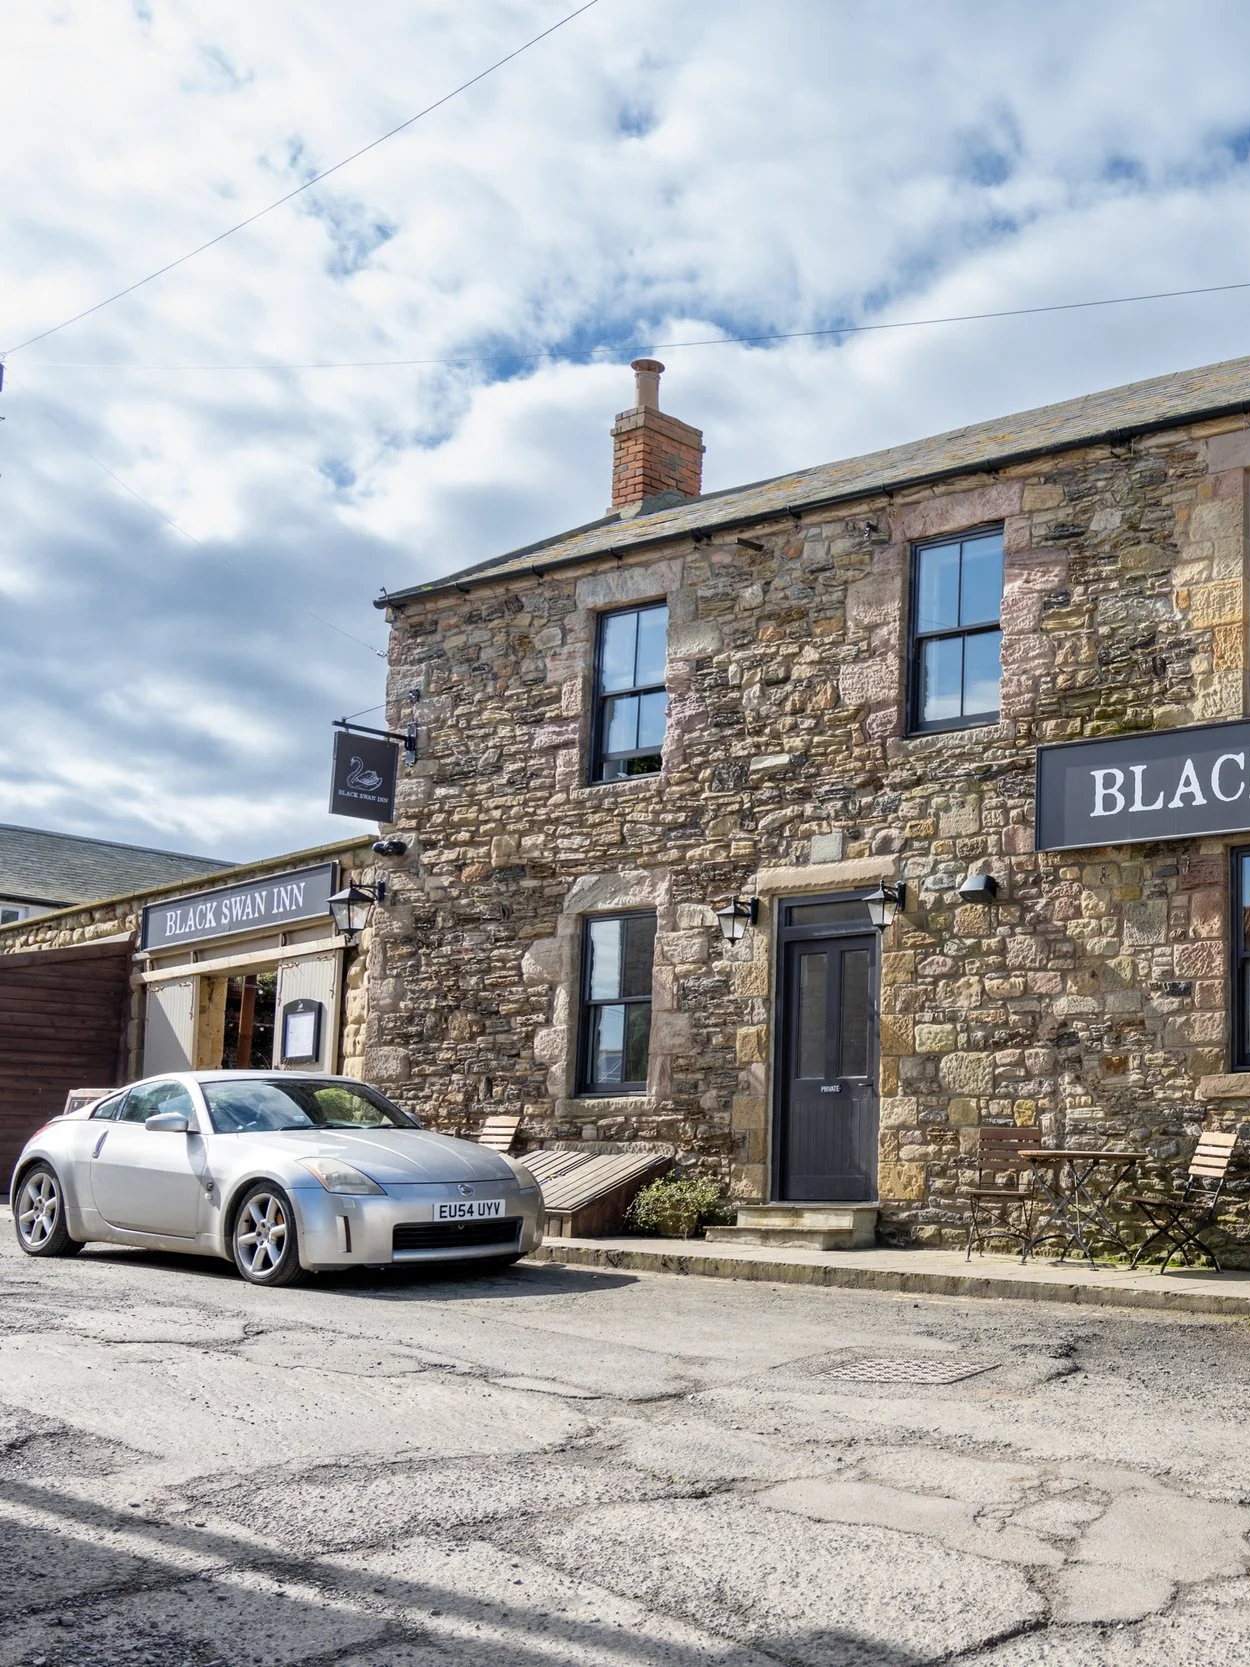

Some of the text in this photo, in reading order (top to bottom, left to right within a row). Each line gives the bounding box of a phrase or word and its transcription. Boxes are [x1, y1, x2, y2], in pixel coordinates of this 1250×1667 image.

[338, 789, 359, 798] BLACK
[360, 793, 377, 801] SWAN
[165, 882, 305, 936] BLACK SWAN INN
[820, 1085, 840, 1093] PRIVATE
[439, 1202, 500, 1219] EU54 UYV
